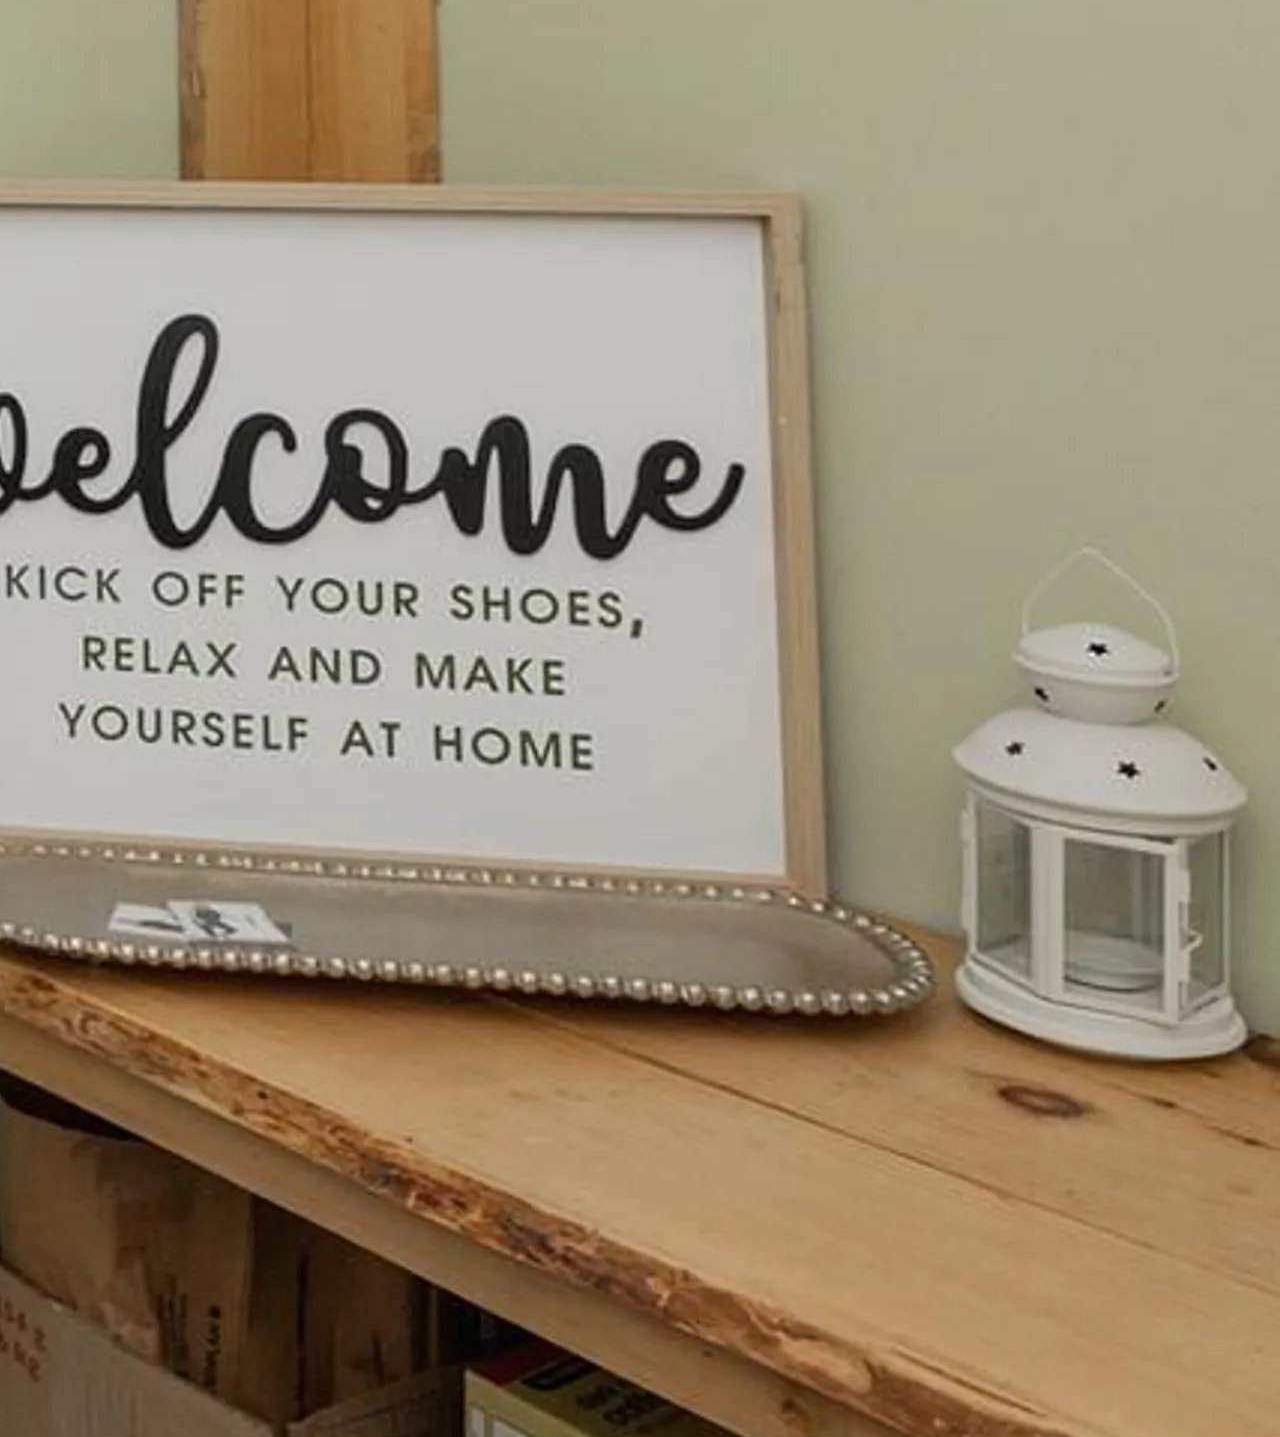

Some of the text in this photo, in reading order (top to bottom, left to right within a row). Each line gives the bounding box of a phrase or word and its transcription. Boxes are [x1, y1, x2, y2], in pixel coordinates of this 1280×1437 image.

[5, 564, 644, 639] KICK OFF YOUR SHOES,
[82, 635, 566, 696] RELAX AND MAKE
[59, 703, 594, 771] YOURSELF AT HOME
